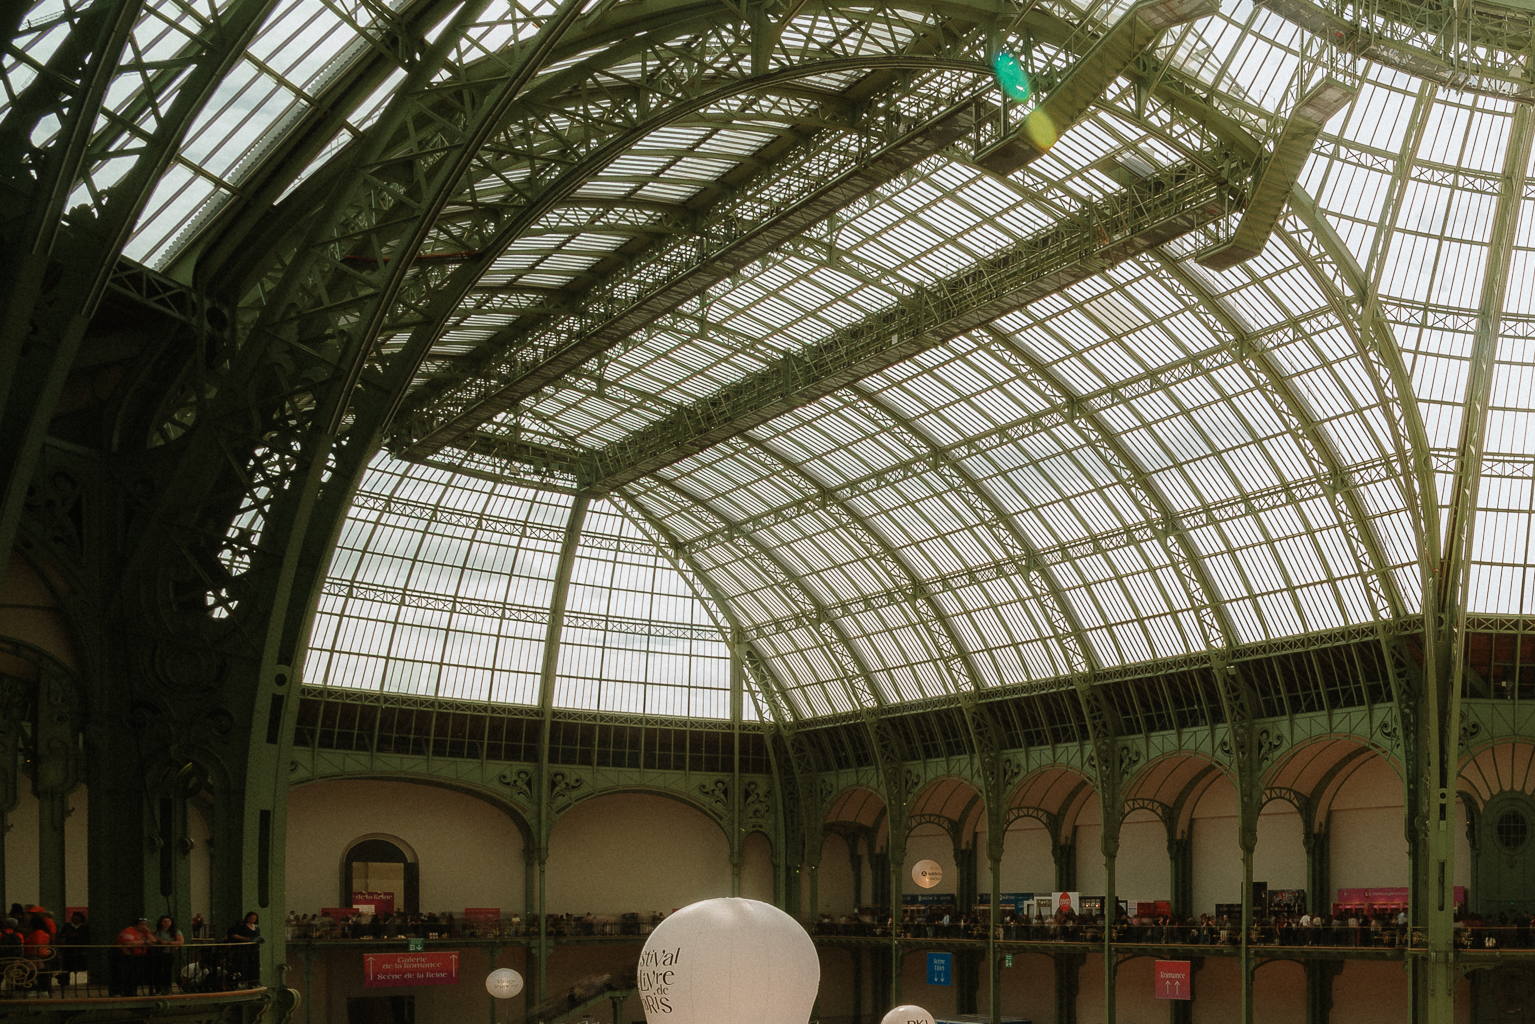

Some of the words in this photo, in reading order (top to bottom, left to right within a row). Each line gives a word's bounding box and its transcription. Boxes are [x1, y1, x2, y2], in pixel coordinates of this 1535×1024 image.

[377, 972, 402, 980] Scène
[638, 969, 675, 992] Livre
[1160, 971, 1186, 980] Romance
[656, 985, 669, 996] de
